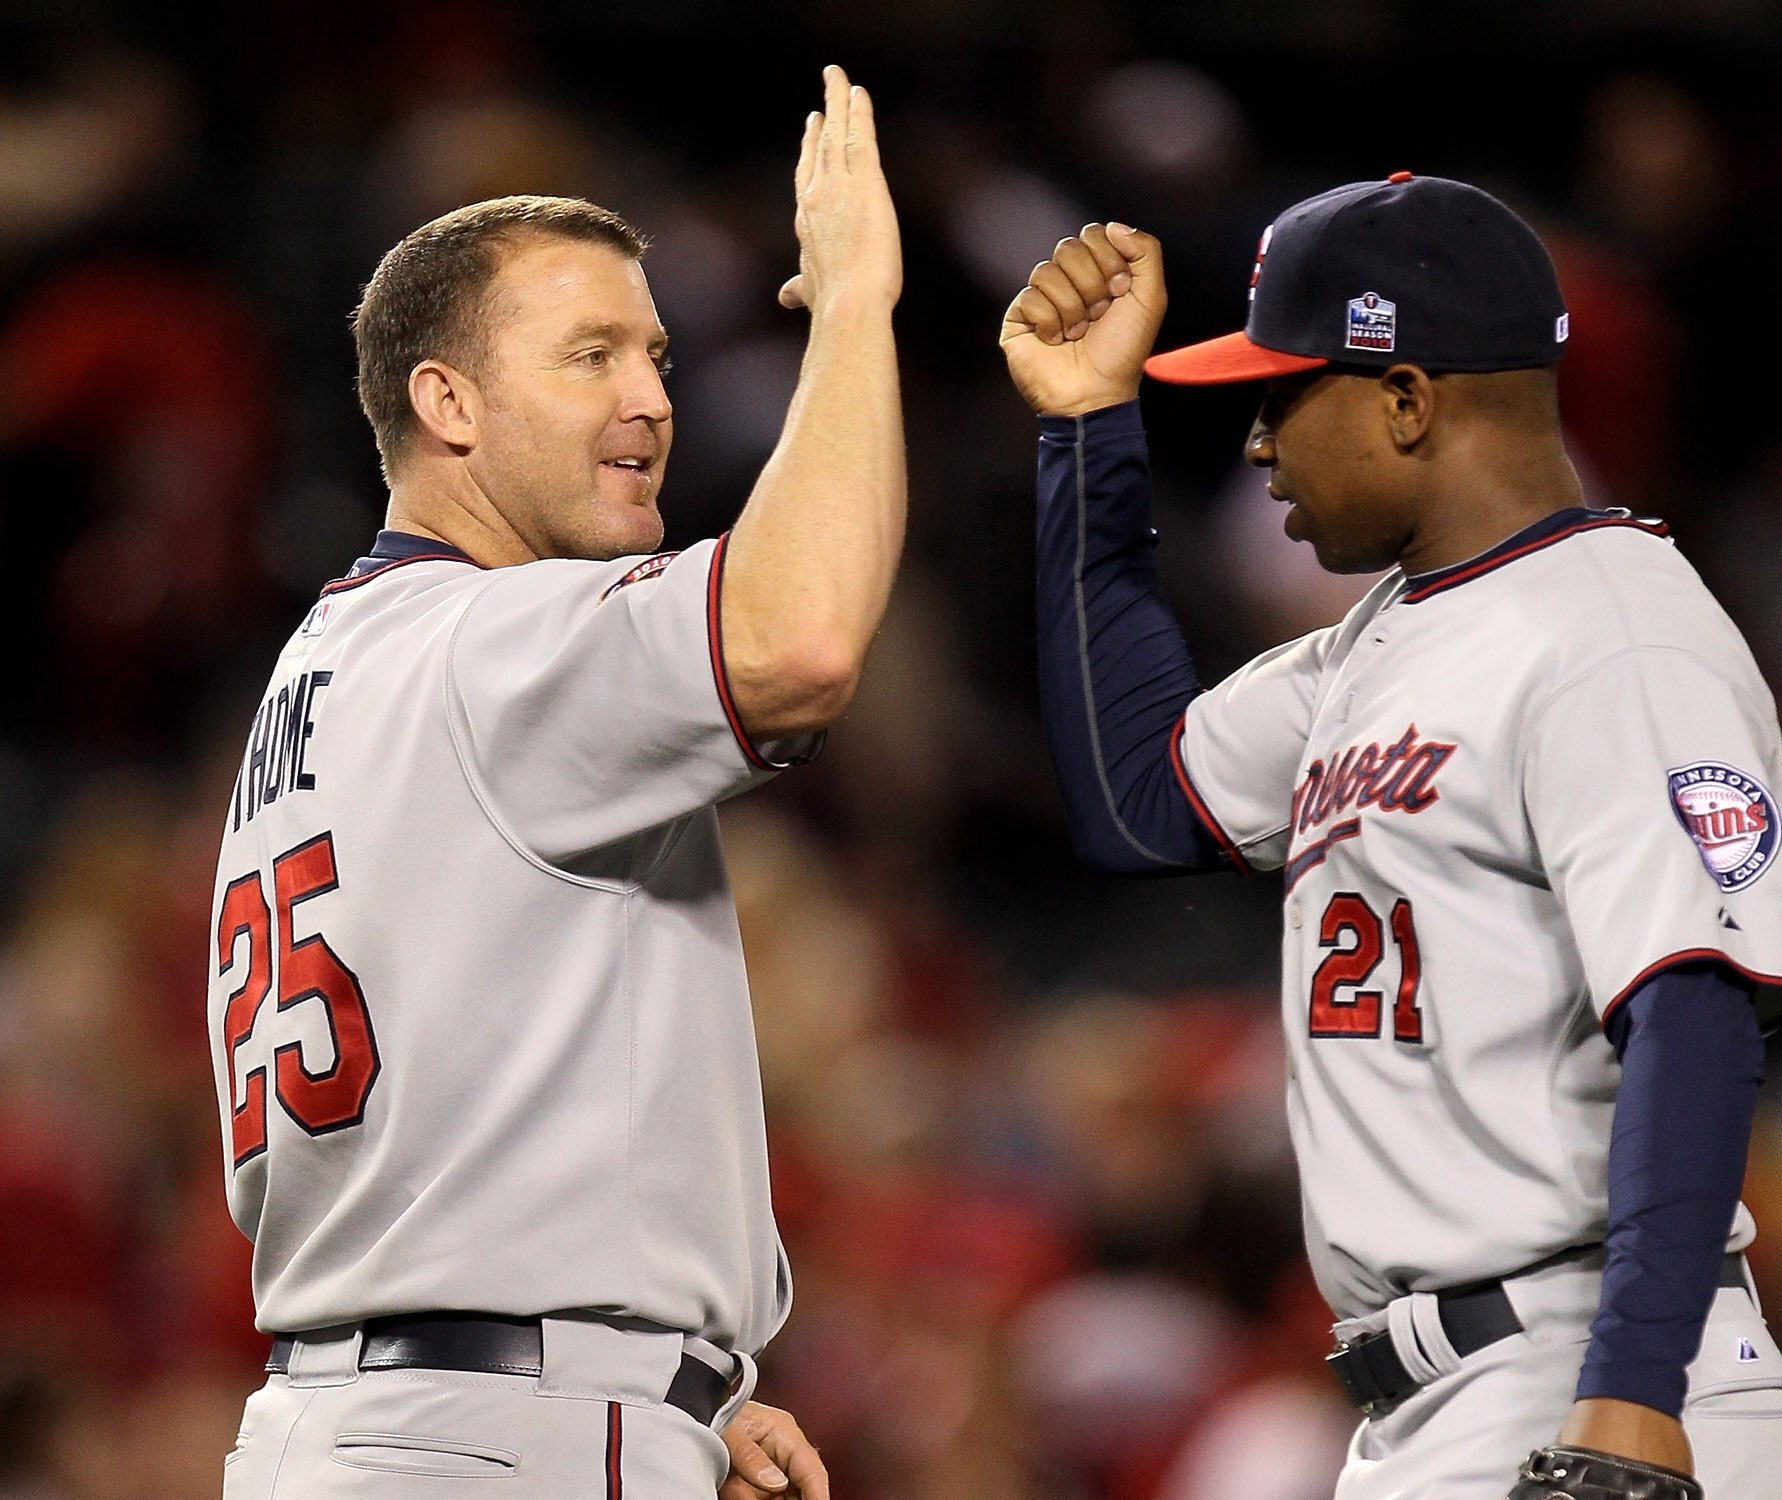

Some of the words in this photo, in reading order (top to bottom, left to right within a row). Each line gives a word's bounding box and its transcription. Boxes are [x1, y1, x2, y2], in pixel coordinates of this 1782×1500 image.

[1351, 337, 1391, 349] 2010
[632, 556, 671, 577] 2010
[1734, 850, 1766, 881] CLUB
[1309, 891, 1423, 1044] 21
[217, 829, 382, 1177] 25
